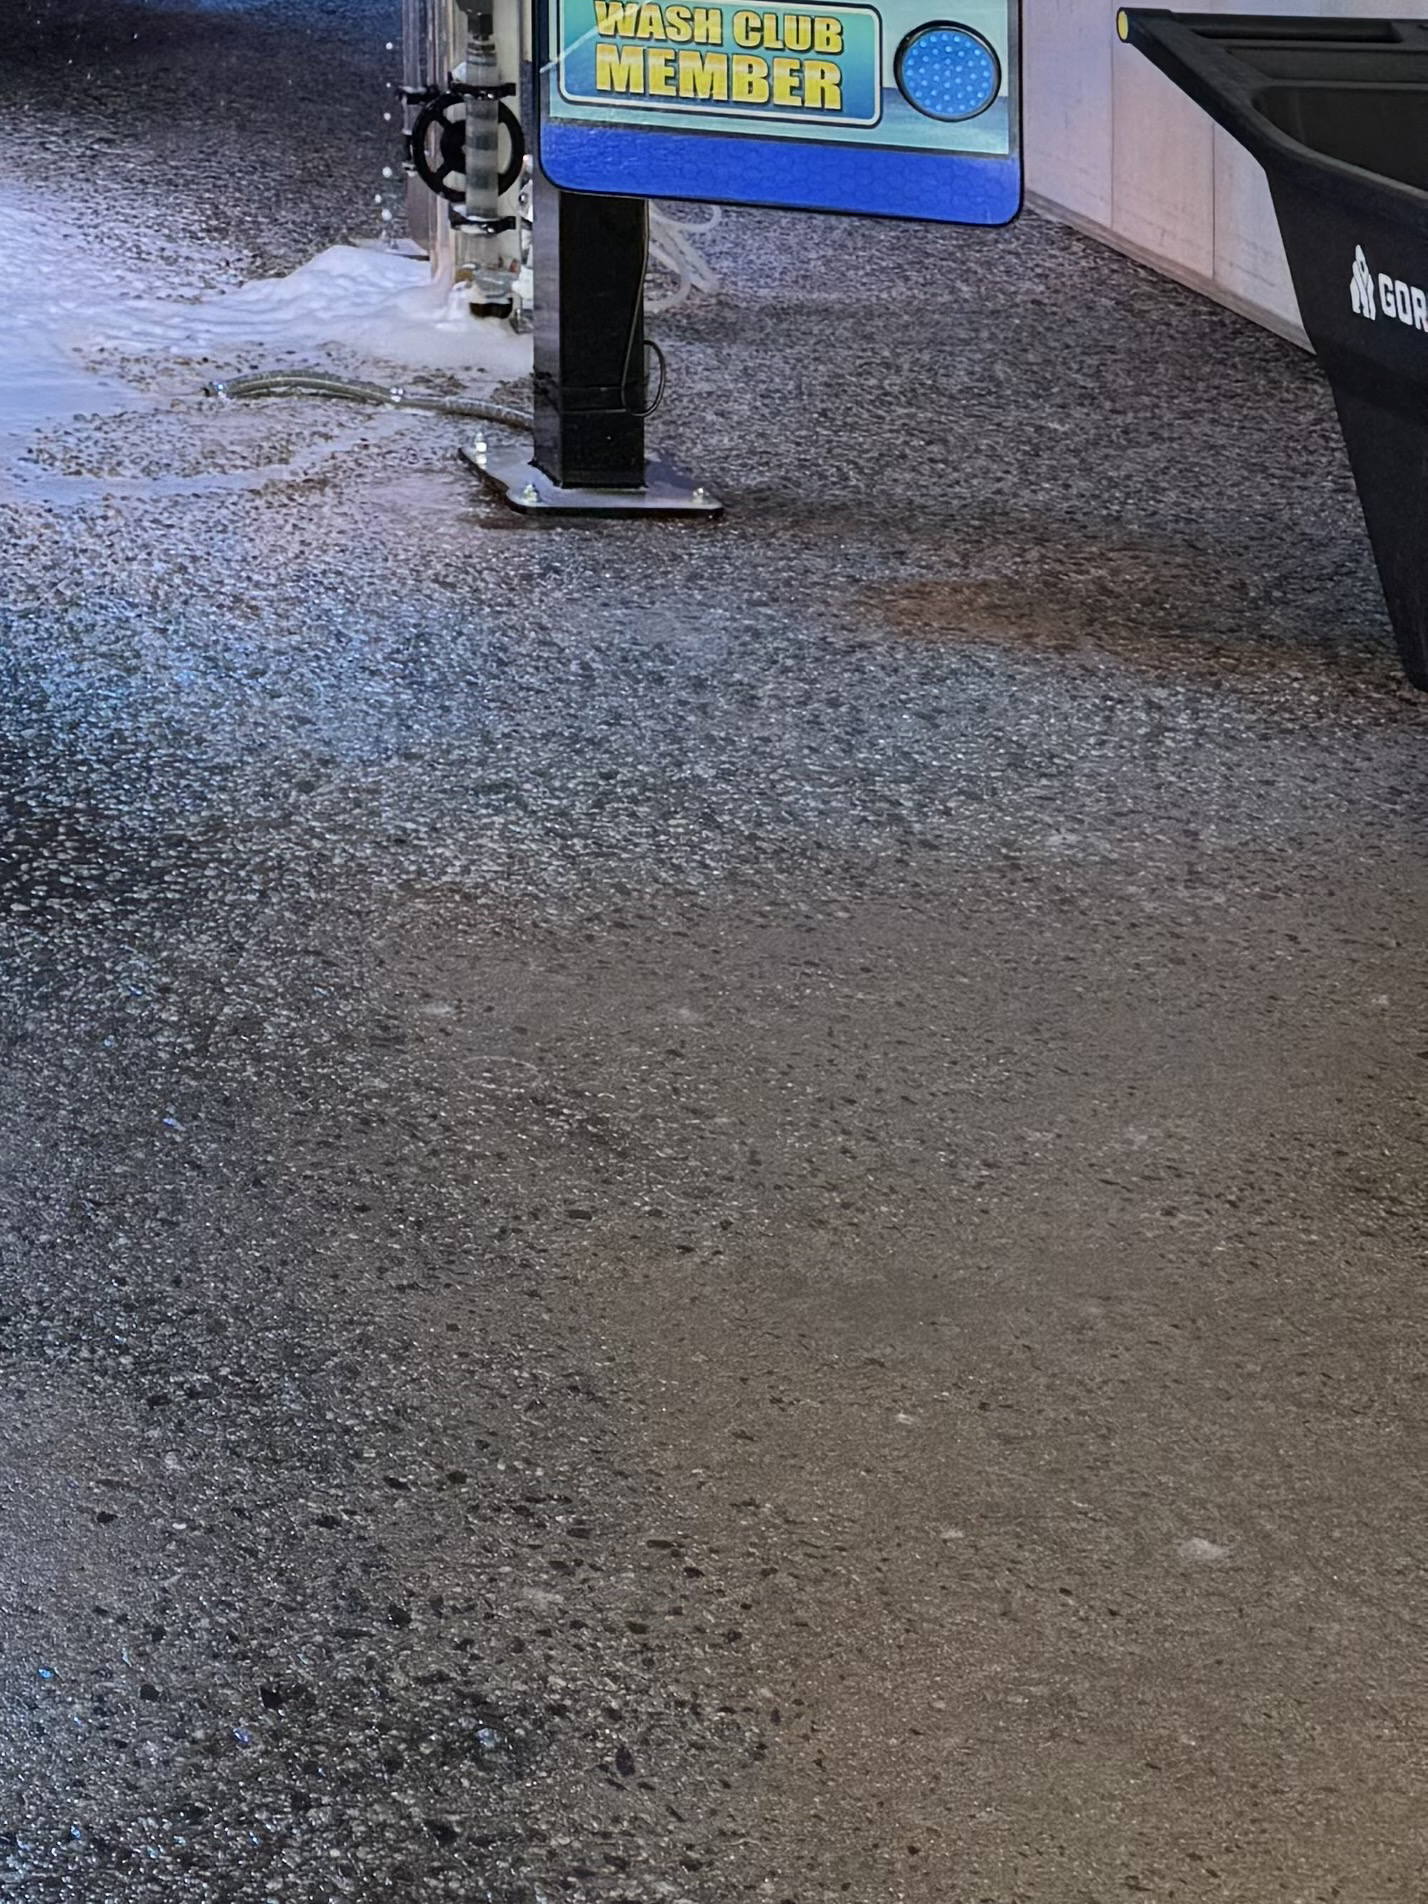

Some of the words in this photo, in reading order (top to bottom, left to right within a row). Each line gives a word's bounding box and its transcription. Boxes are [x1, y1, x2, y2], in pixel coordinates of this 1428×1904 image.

[593, 0, 723, 45] WASH
[732, 10, 843, 54] CLUB
[595, 44, 842, 111] MEMBER
[1377, 272, 1428, 333] GOR
